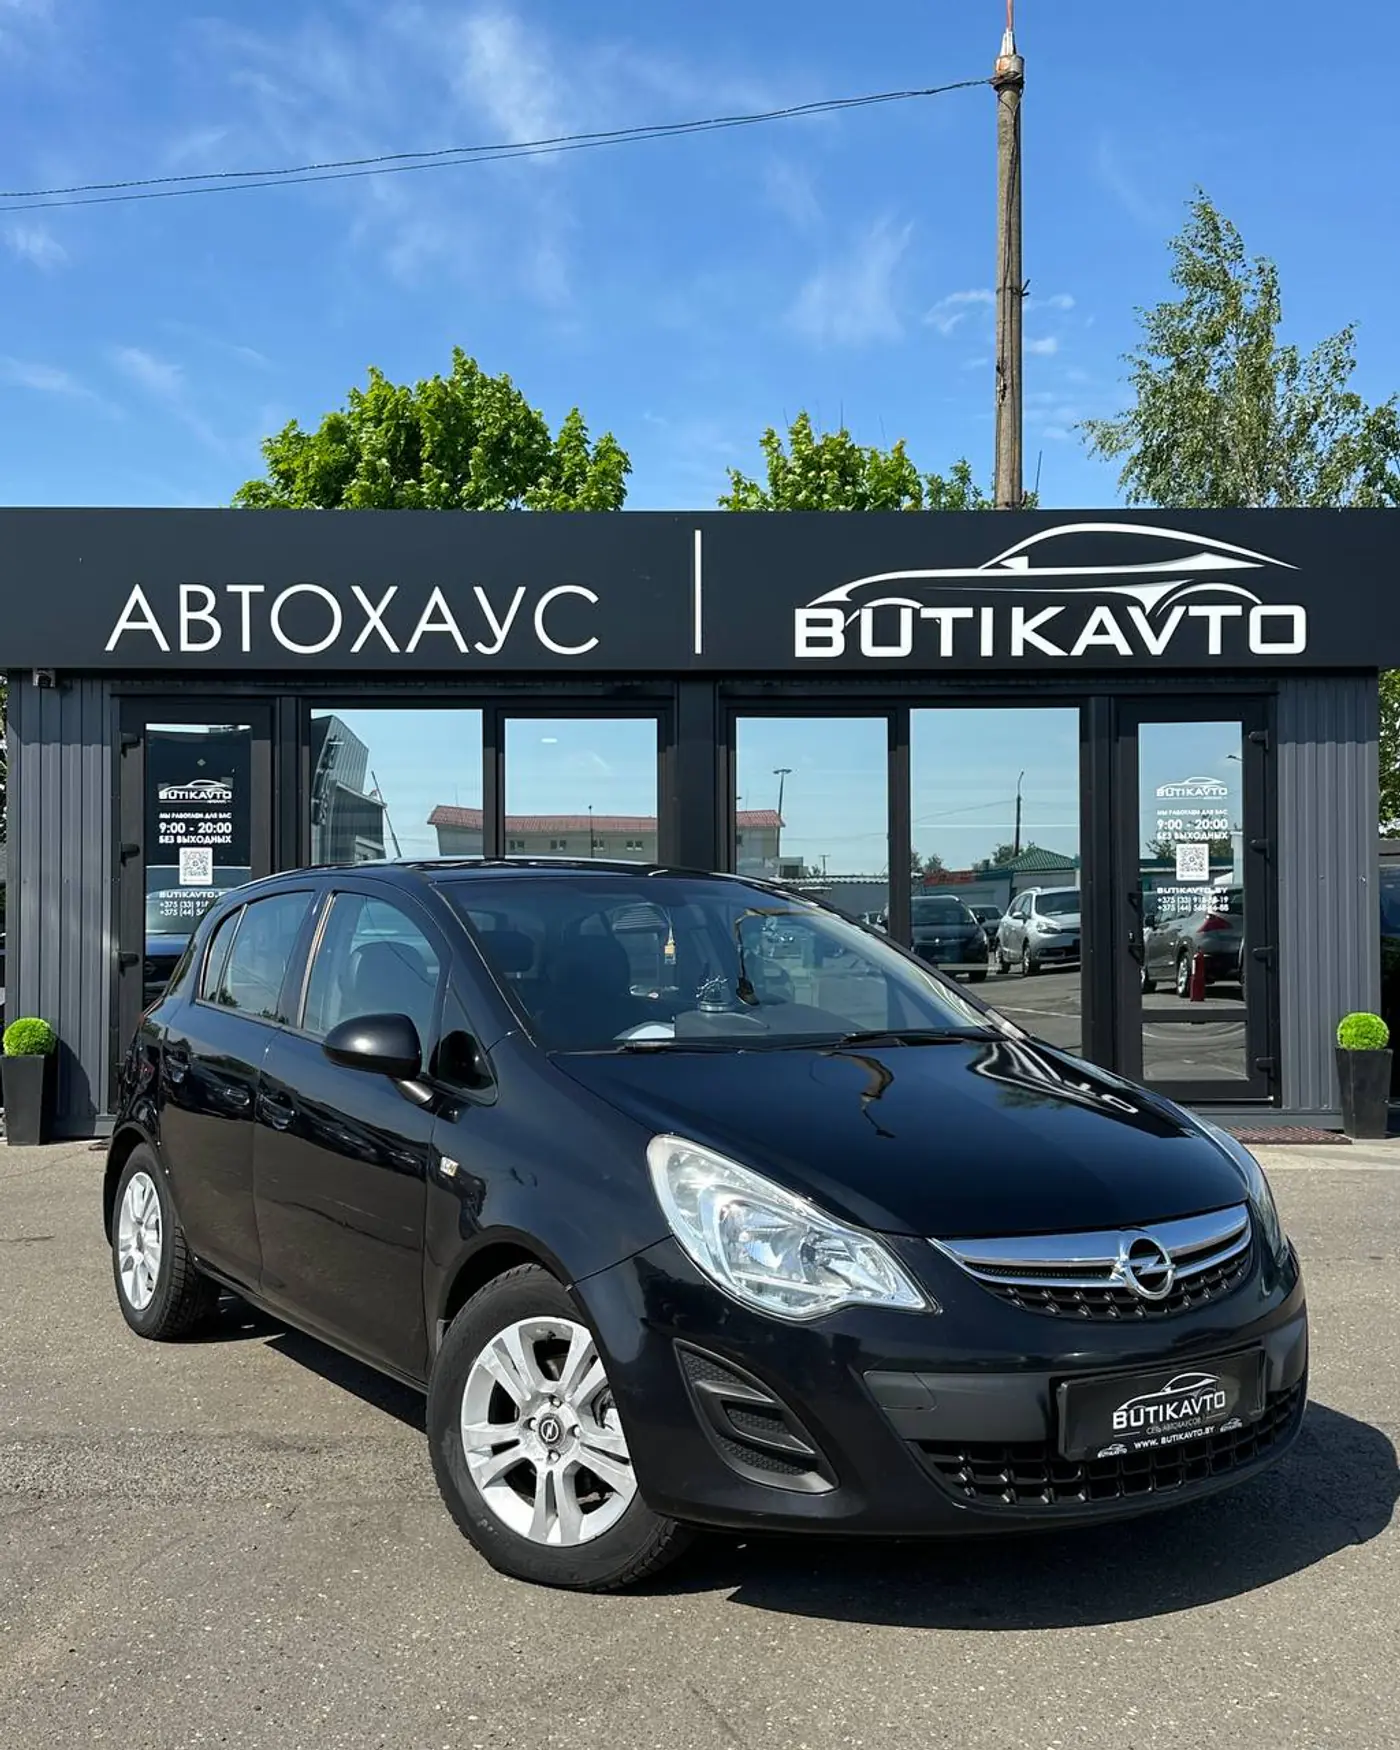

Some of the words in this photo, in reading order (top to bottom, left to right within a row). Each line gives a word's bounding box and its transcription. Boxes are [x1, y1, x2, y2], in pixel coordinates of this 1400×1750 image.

[105, 583, 600, 655] АВТОХАУС
[794, 604, 1307, 658] BUTIKAVTO
[159, 790, 232, 800] BUTIKAVTO
[1156, 787, 1228, 797] BUTIKAVTO
[159, 822, 186, 834] 9:00
[197, 822, 232, 834] 20:00
[1157, 819, 1183, 830] 9:00
[1194, 819, 1228, 830] 20:00
[159, 835, 175, 844] БЕЗ
[176, 835, 232, 845] ВЫХОДНЫХ
[1174, 831, 1228, 841] ВЫХОДНЫХ
[160, 900, 178, 908] +375
[1112, 1390, 1226, 1430] BUTIKAVTO
[1133, 1439, 1158, 1449] WWW.
[1160, 1426, 1215, 1445] BUTIKAVTO.BY
